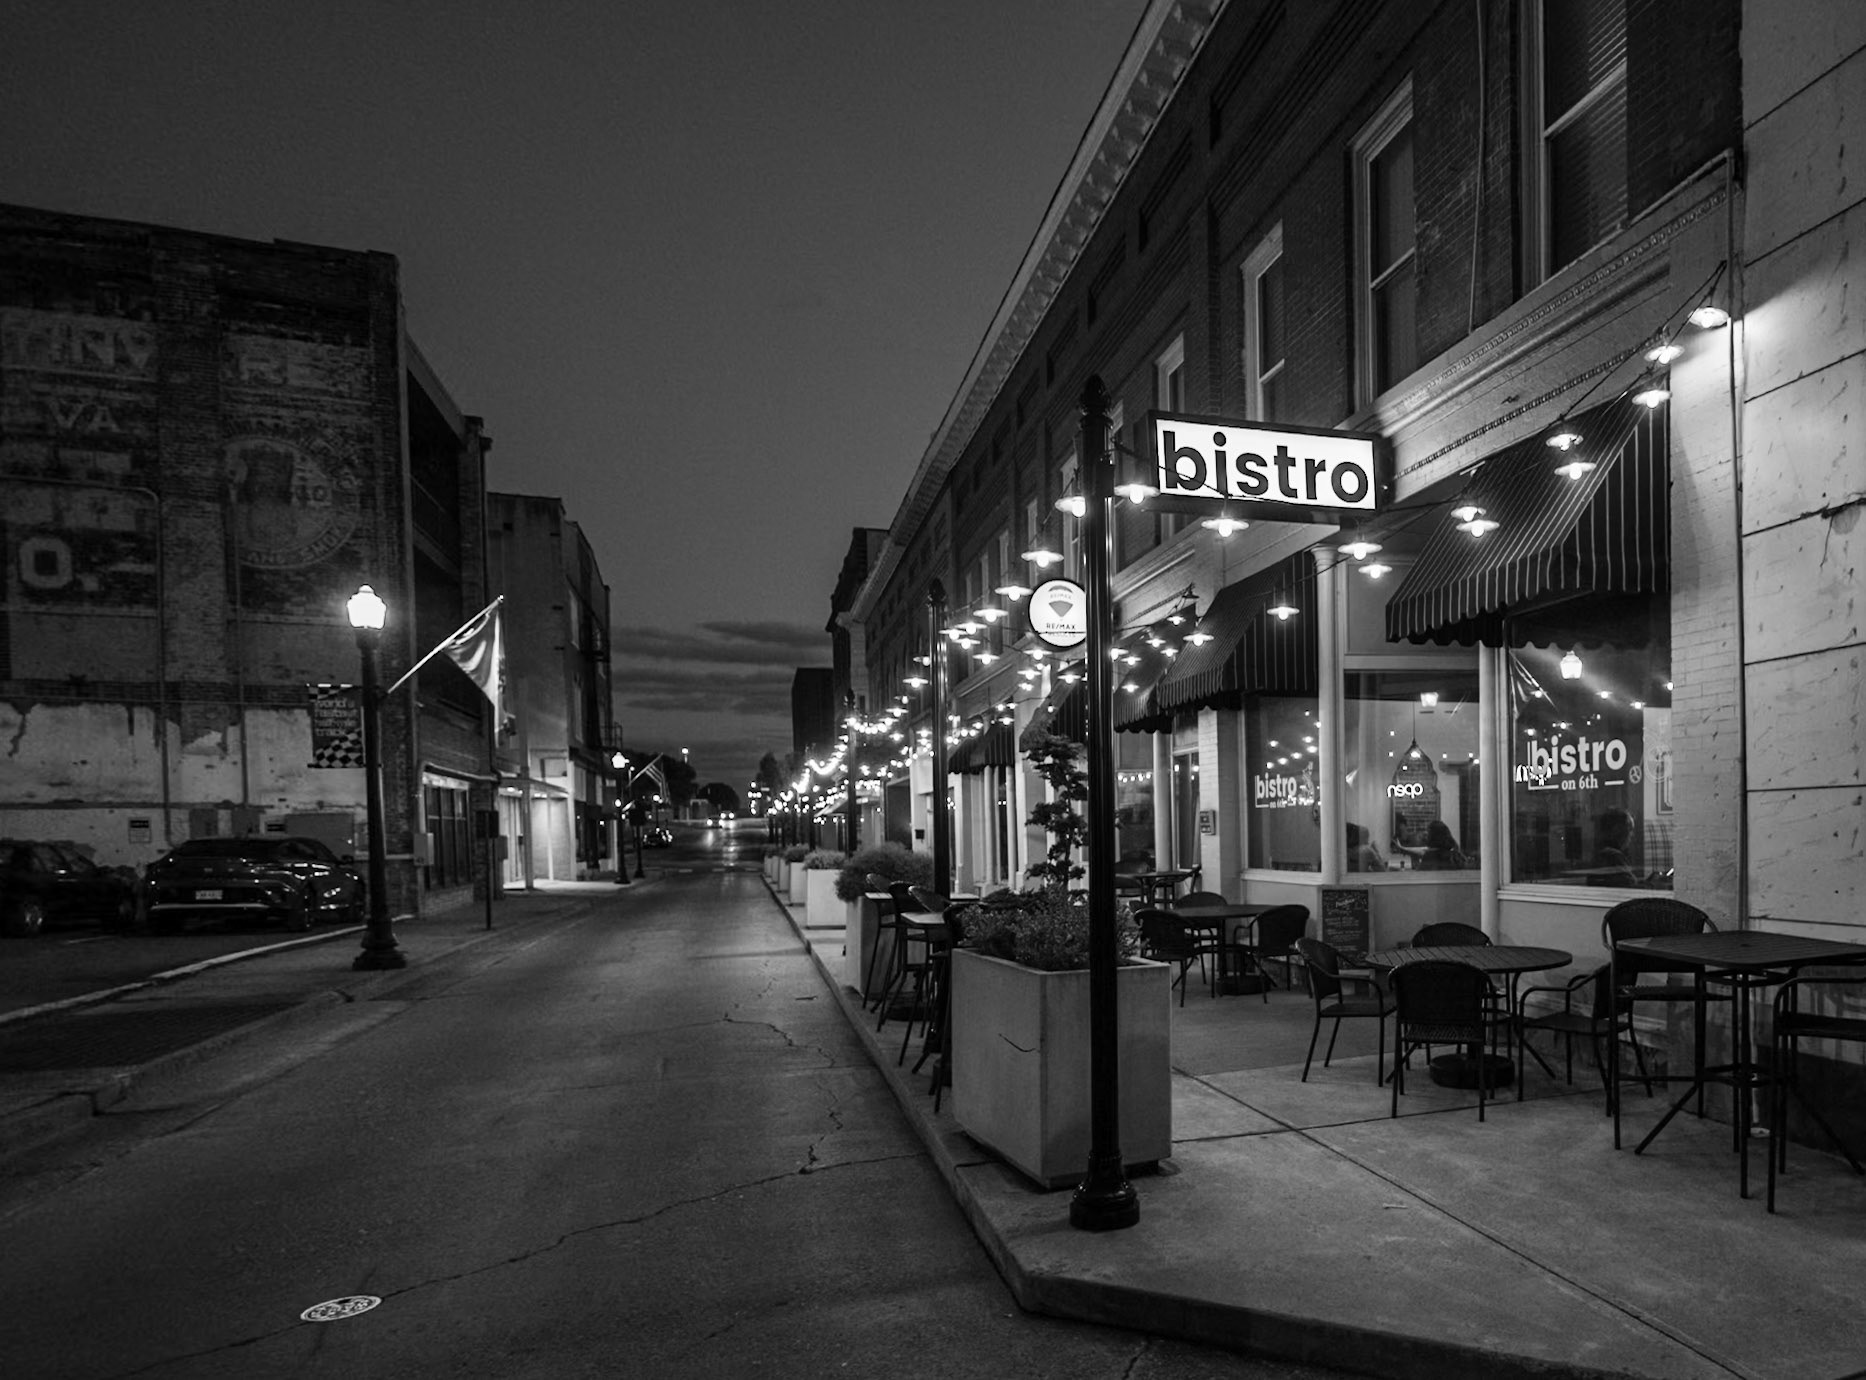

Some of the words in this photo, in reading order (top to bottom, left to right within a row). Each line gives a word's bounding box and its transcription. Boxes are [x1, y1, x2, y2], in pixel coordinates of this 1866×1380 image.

[1163, 430, 1369, 503] bistro
[1046, 622, 1076, 630] RE/MAX
[1531, 735, 1627, 775] bistro
[1256, 772, 1297, 799] bistro
[1561, 778, 1577, 790] on
[1579, 774, 1599, 790] 6th
